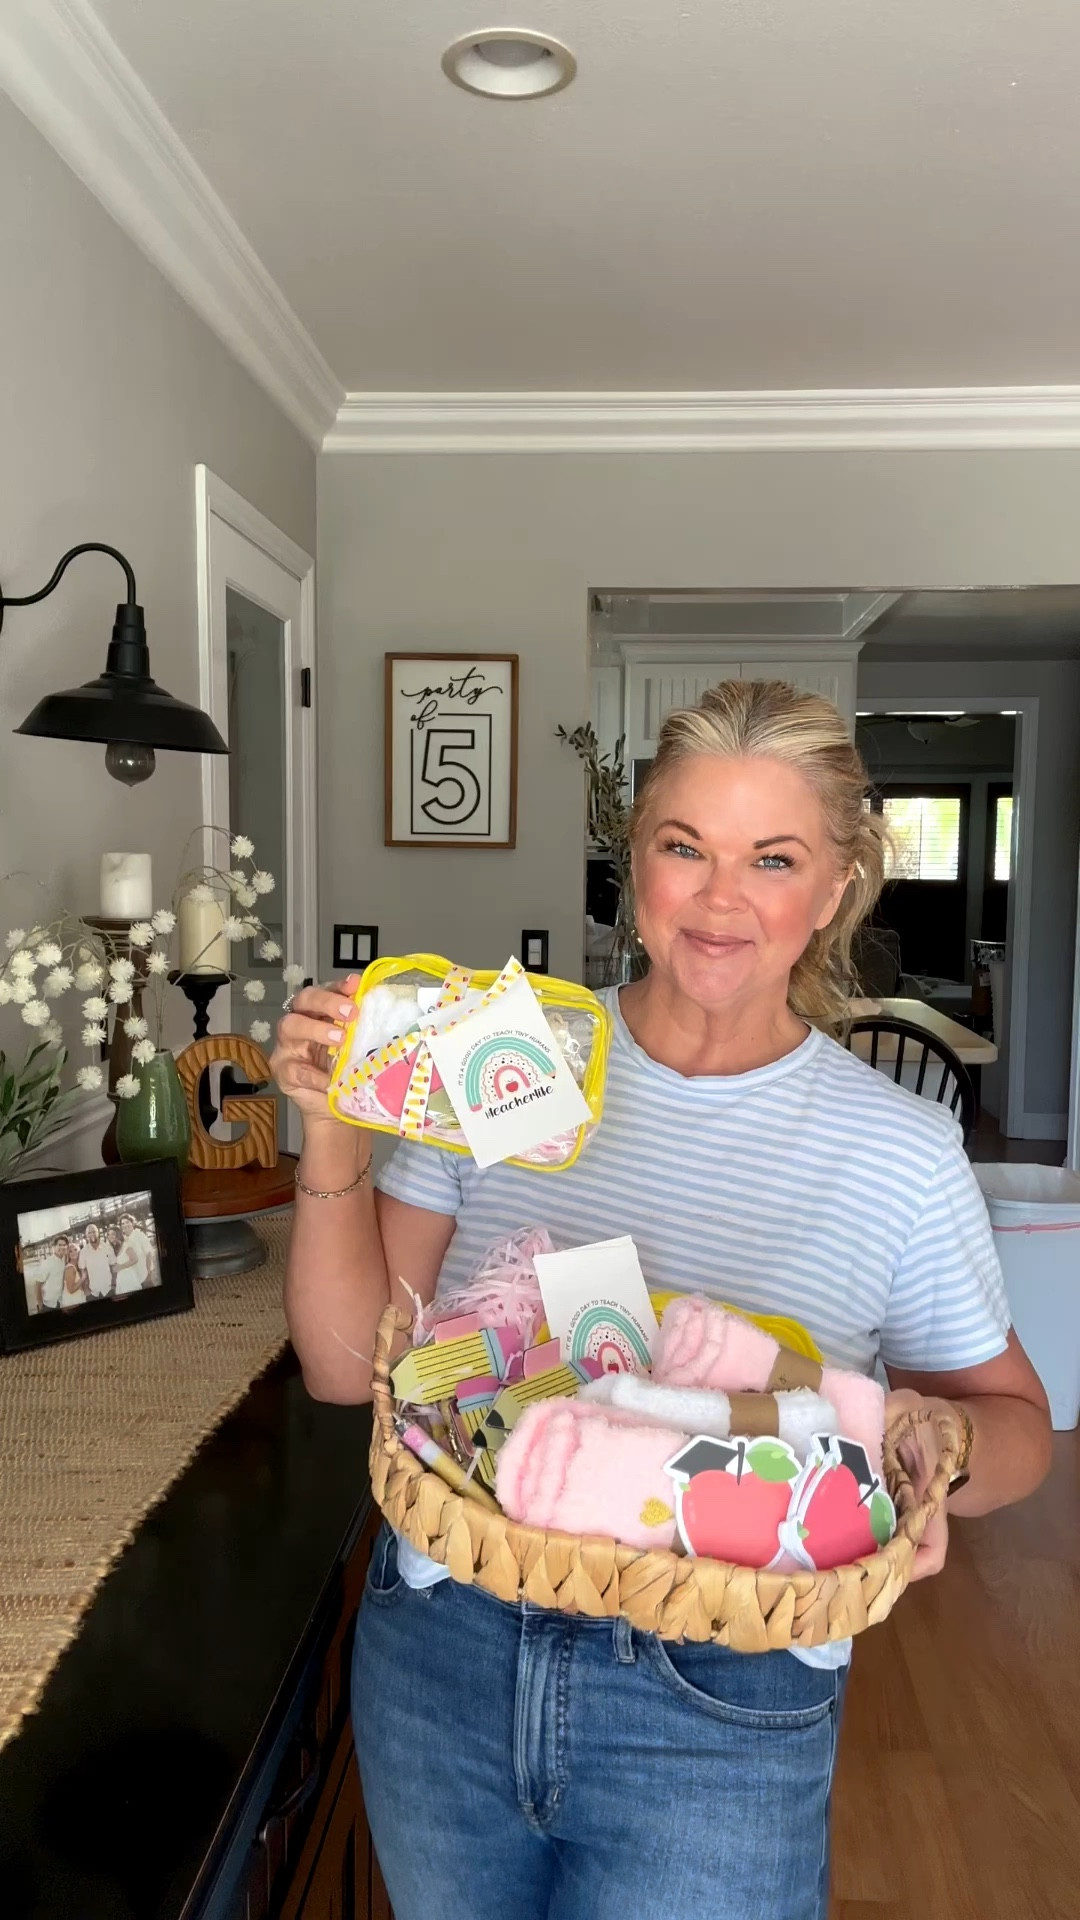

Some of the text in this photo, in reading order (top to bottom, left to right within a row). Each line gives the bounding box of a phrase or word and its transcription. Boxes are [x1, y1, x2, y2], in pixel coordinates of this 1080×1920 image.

[400, 667, 503, 705] party
[410, 700, 438, 730] of
[421, 729, 481, 826] 5
[461, 1051, 472, 1066] GOOD
[470, 1039, 482, 1050] DAY
[492, 1029, 513, 1037] TEACH
[529, 1035, 551, 1053] HUMANS
[570, 1311, 580, 1328] GOOD
[580, 1303, 590, 1312] DAY
[600, 1299, 618, 1308] TEACH
[619, 1305, 631, 1316] TINY
[631, 1316, 649, 1342] HUMANS
